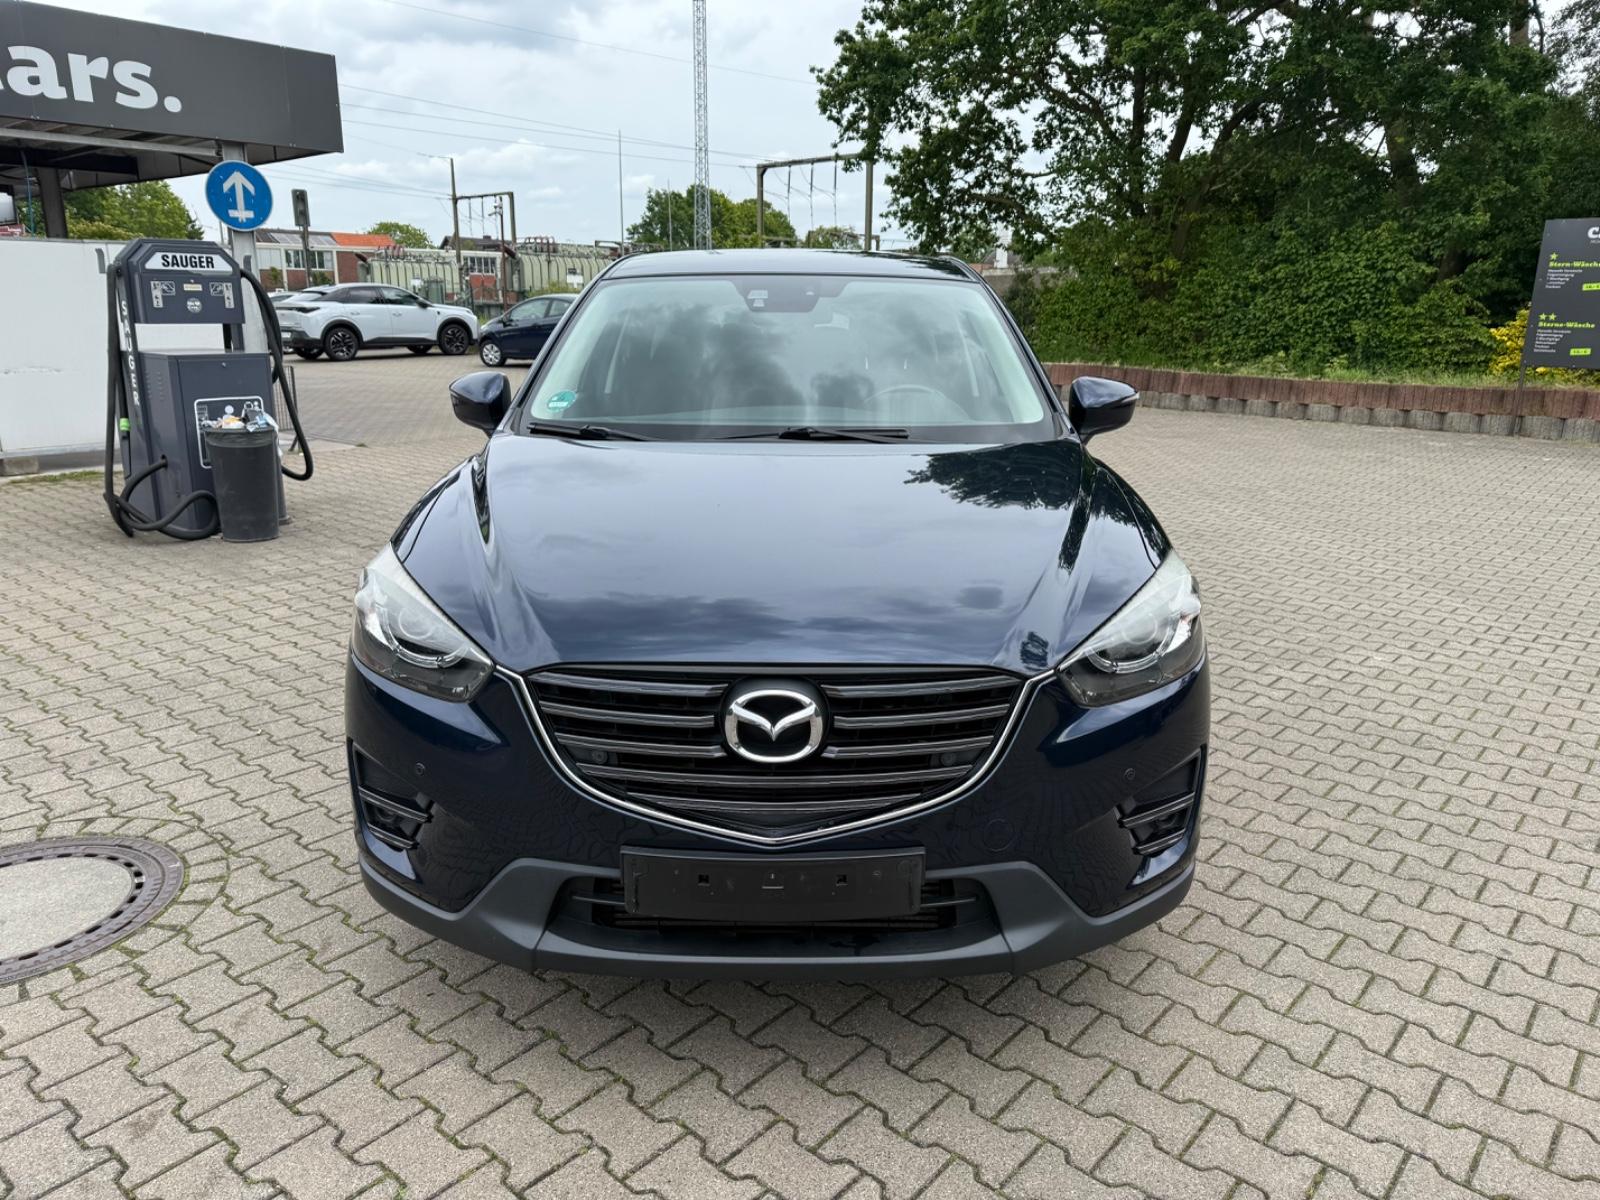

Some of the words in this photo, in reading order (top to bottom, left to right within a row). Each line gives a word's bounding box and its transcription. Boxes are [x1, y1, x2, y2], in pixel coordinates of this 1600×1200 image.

[0, 46, 182, 113] ars.
[161, 253, 215, 269] SAUGER
[121, 300, 140, 406] SAUGER
